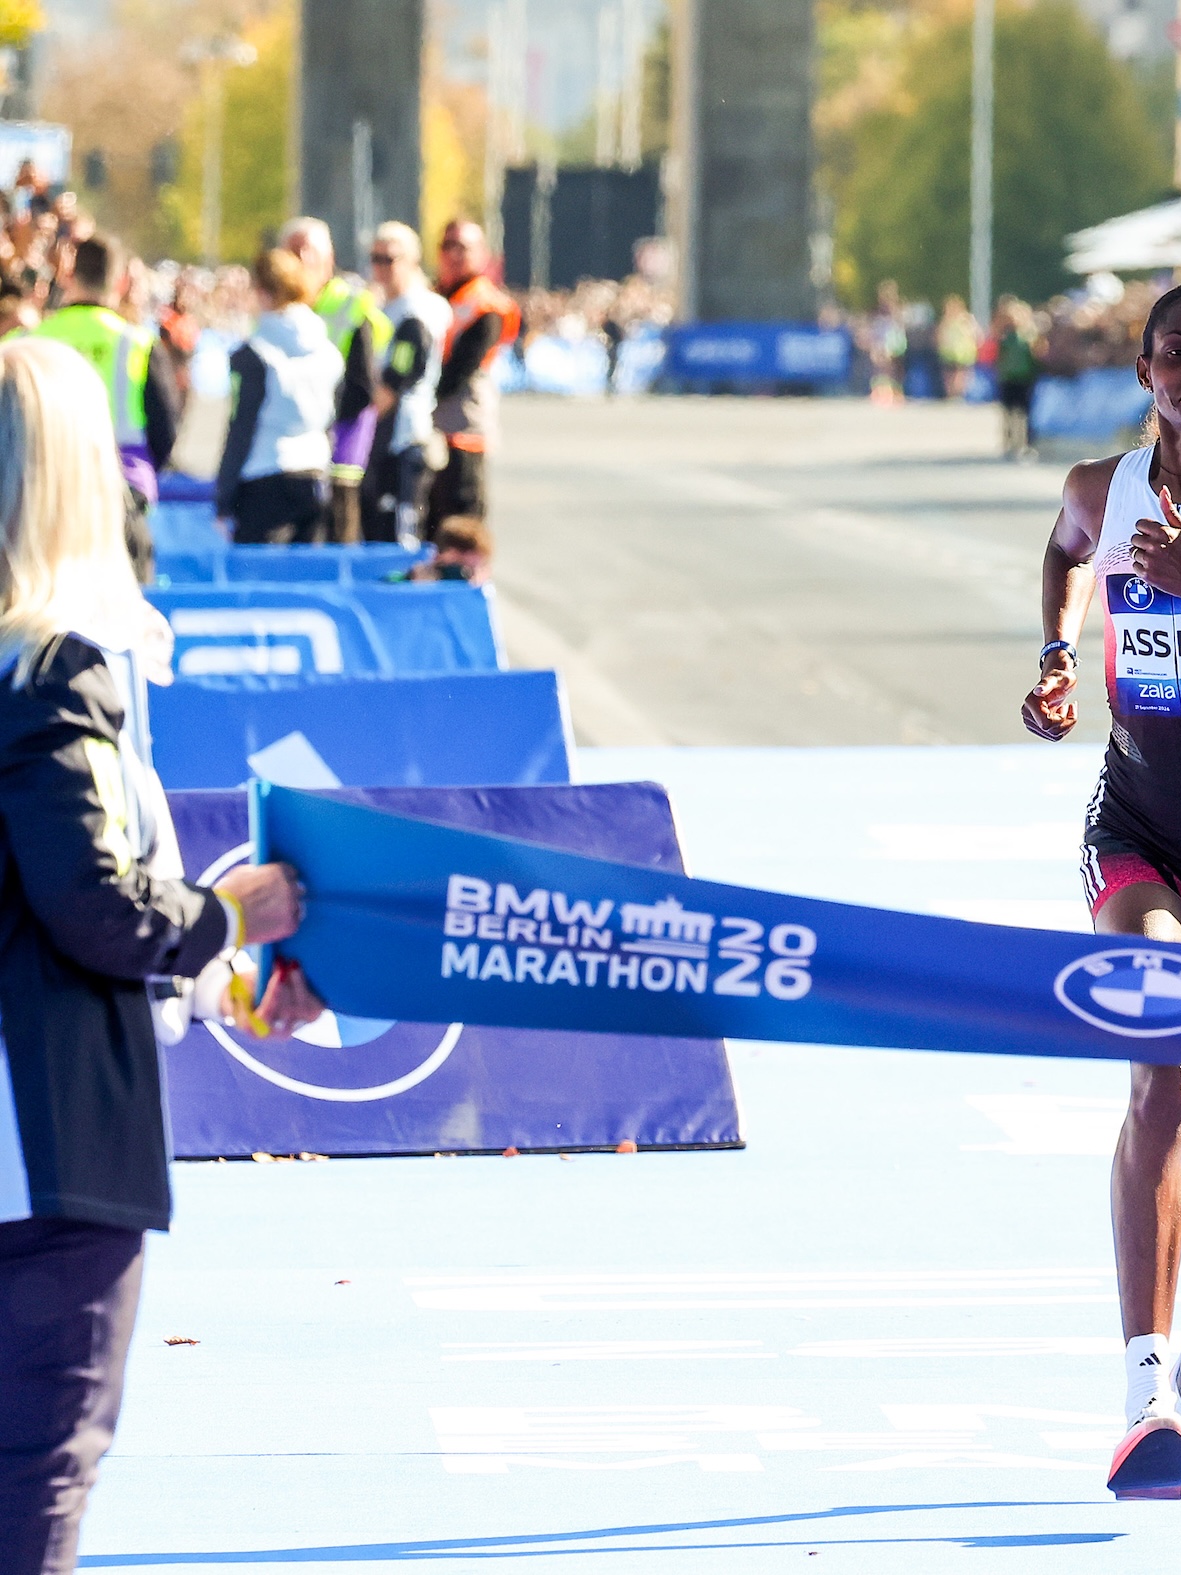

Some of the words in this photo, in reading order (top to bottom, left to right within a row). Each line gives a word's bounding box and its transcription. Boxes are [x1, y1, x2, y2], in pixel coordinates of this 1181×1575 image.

[446, 874, 615, 927] BMW
[444, 910, 613, 951] BERLIN
[718, 917, 817, 958] 20
[441, 941, 709, 995] MARATHON
[712, 950, 812, 1000] 26
